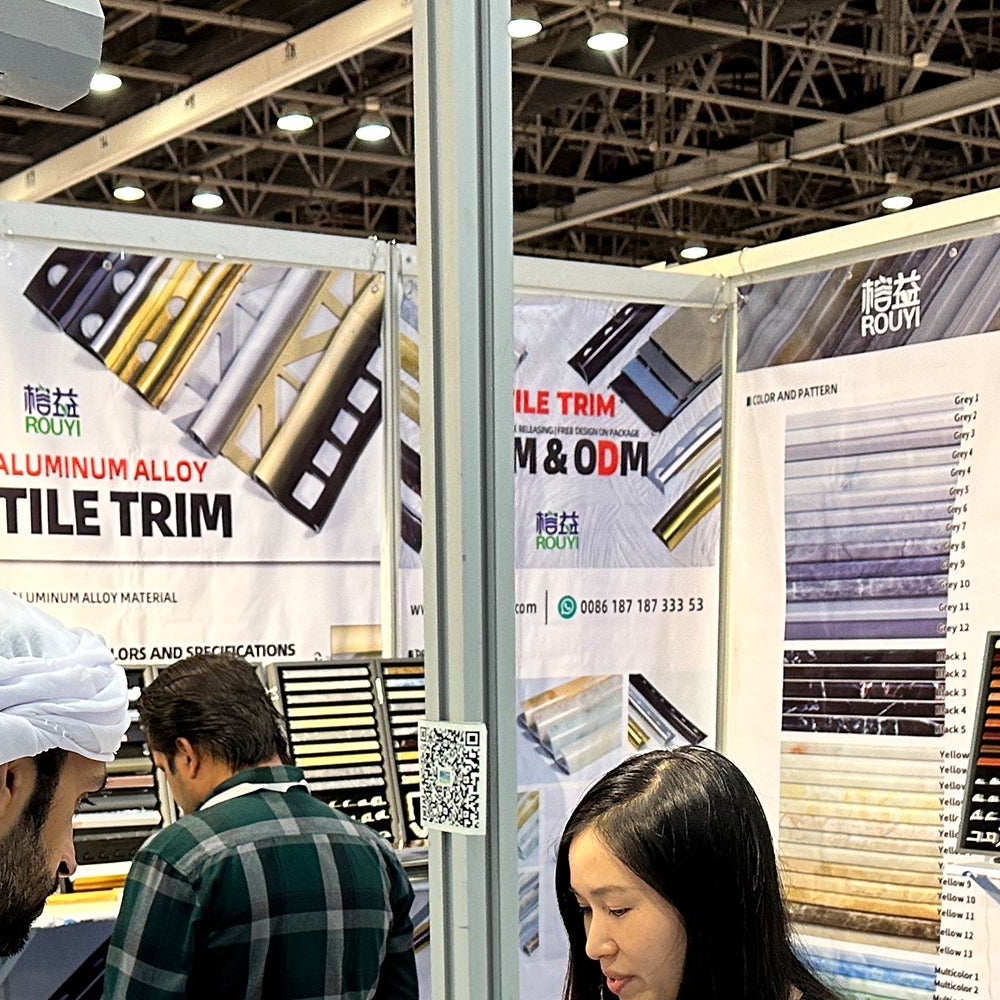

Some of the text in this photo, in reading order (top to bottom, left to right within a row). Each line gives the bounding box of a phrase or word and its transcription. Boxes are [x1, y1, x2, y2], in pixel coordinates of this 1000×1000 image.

[861, 306, 921, 337] ROUYI
[752, 384, 838, 405] COLOR AND PATTERN
[514, 389, 615, 418] ILE TRIM
[25, 416, 81, 437] ROUYI
[543, 438, 568, 475] &
[574, 438, 649, 476] ODM
[134, 458, 208, 483] ALLOY
[110, 491, 233, 538] TRIM
[536, 535, 579, 550] ROUYI
[12, 591, 178, 604] UMINUM ALLOY MATERIAL
[580, 597, 704, 614] 0086 187 187 333 53
[150, 646, 183, 660] AND
[939, 750, 970, 759] Yellow
[939, 798, 963, 806] Yello
[938, 877, 965, 887] Yellow
[937, 892, 964, 903] Yellow
[937, 908, 963, 919] Yellow
[935, 927, 963, 938] Yellow
[936, 946, 961, 956] Yellow
[934, 966, 973, 980] Multicolor
[934, 979, 973, 993] Multicolor
